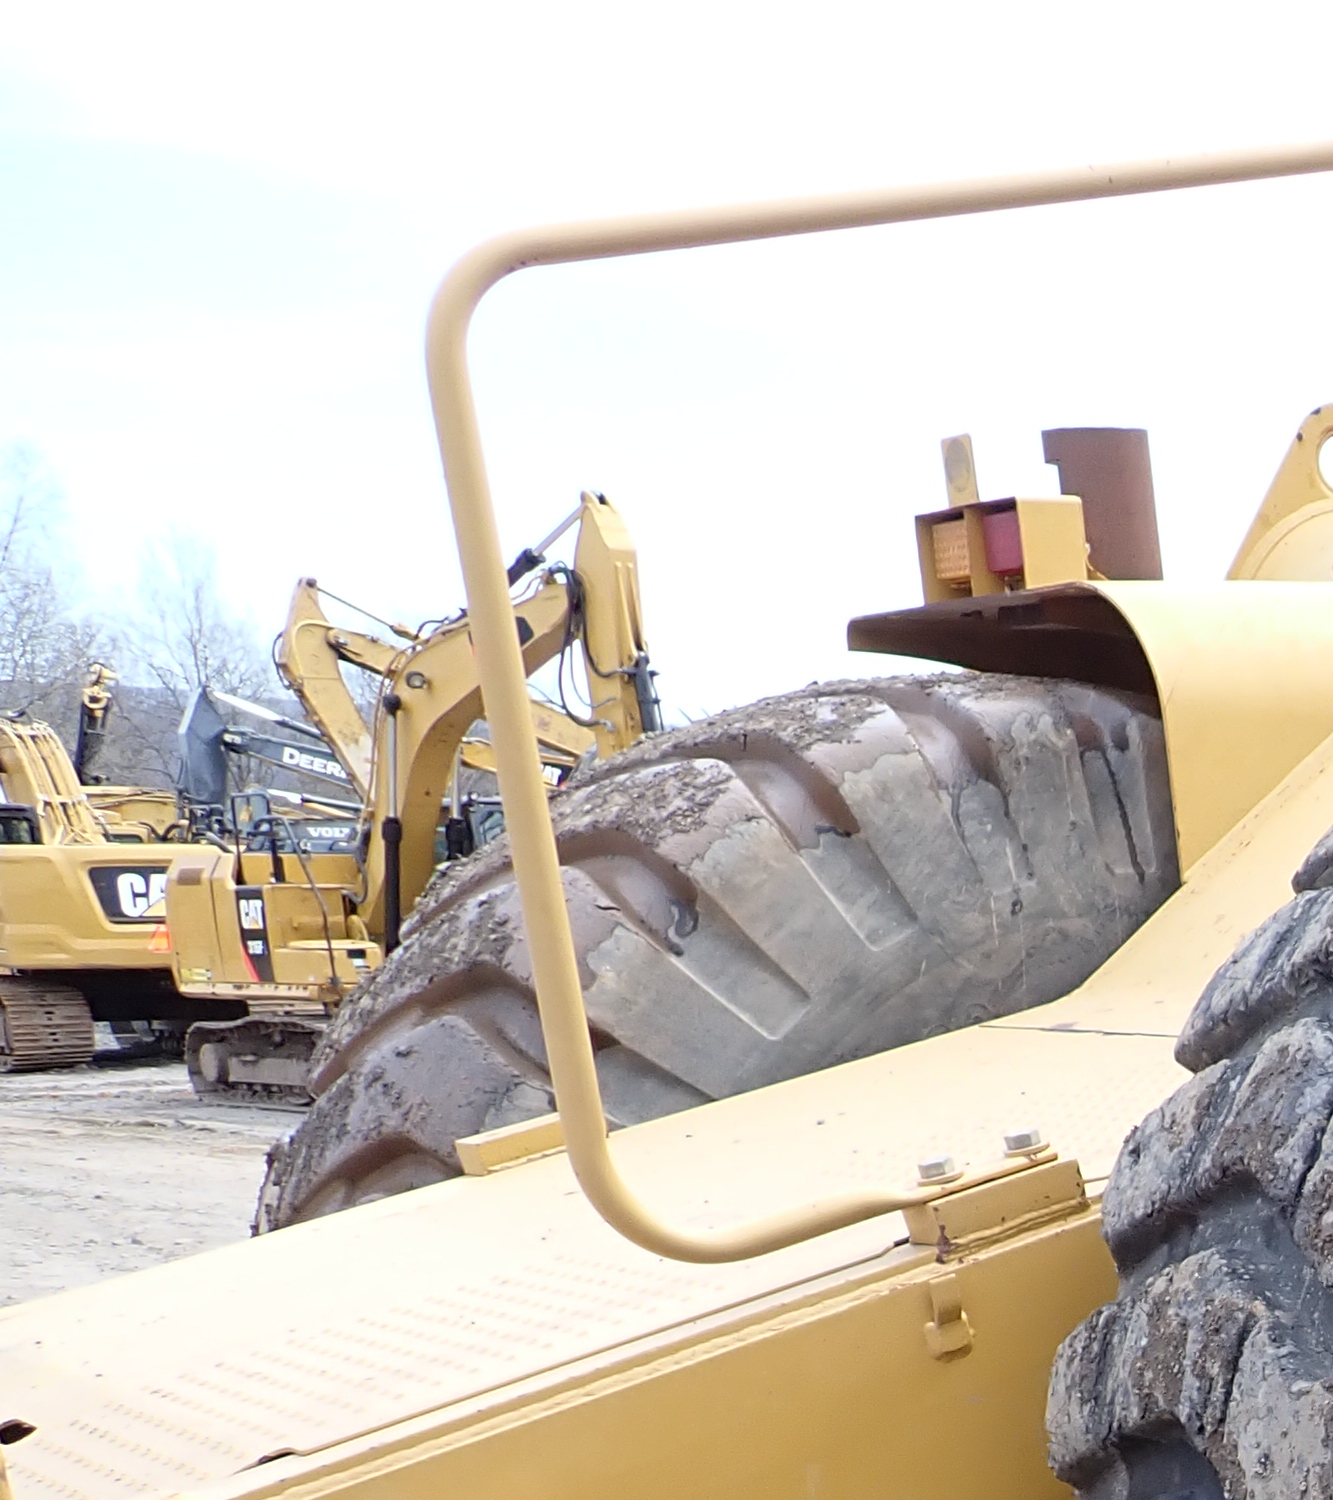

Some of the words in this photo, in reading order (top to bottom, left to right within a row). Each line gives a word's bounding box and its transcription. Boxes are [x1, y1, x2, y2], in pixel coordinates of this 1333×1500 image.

[282, 746, 347, 779] DEER
[540, 763, 562, 786] AT
[116, 872, 167, 918] CA
[239, 899, 265, 930] CAT
